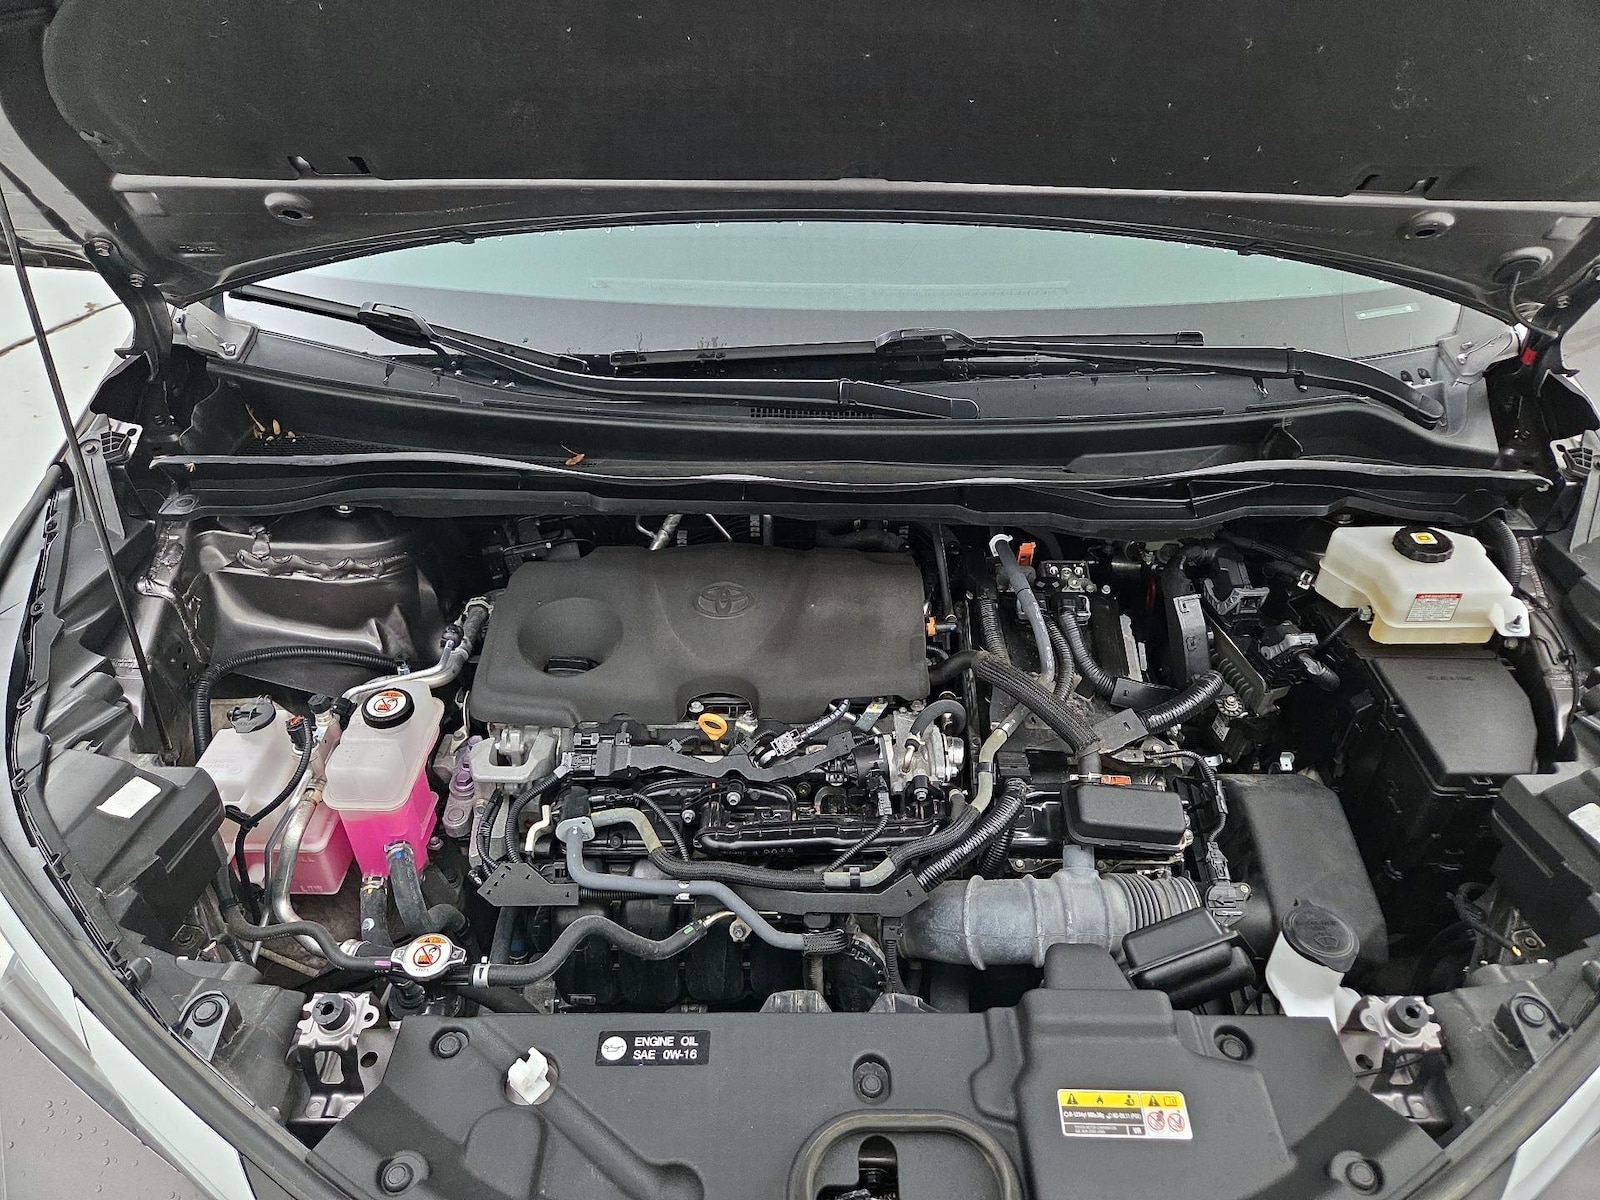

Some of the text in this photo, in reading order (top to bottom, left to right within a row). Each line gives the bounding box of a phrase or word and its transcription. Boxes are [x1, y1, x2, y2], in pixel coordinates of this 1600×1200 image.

[634, 1036, 699, 1047] ENGINE OIL
[632, 1049, 698, 1060] SAE 0W-16
